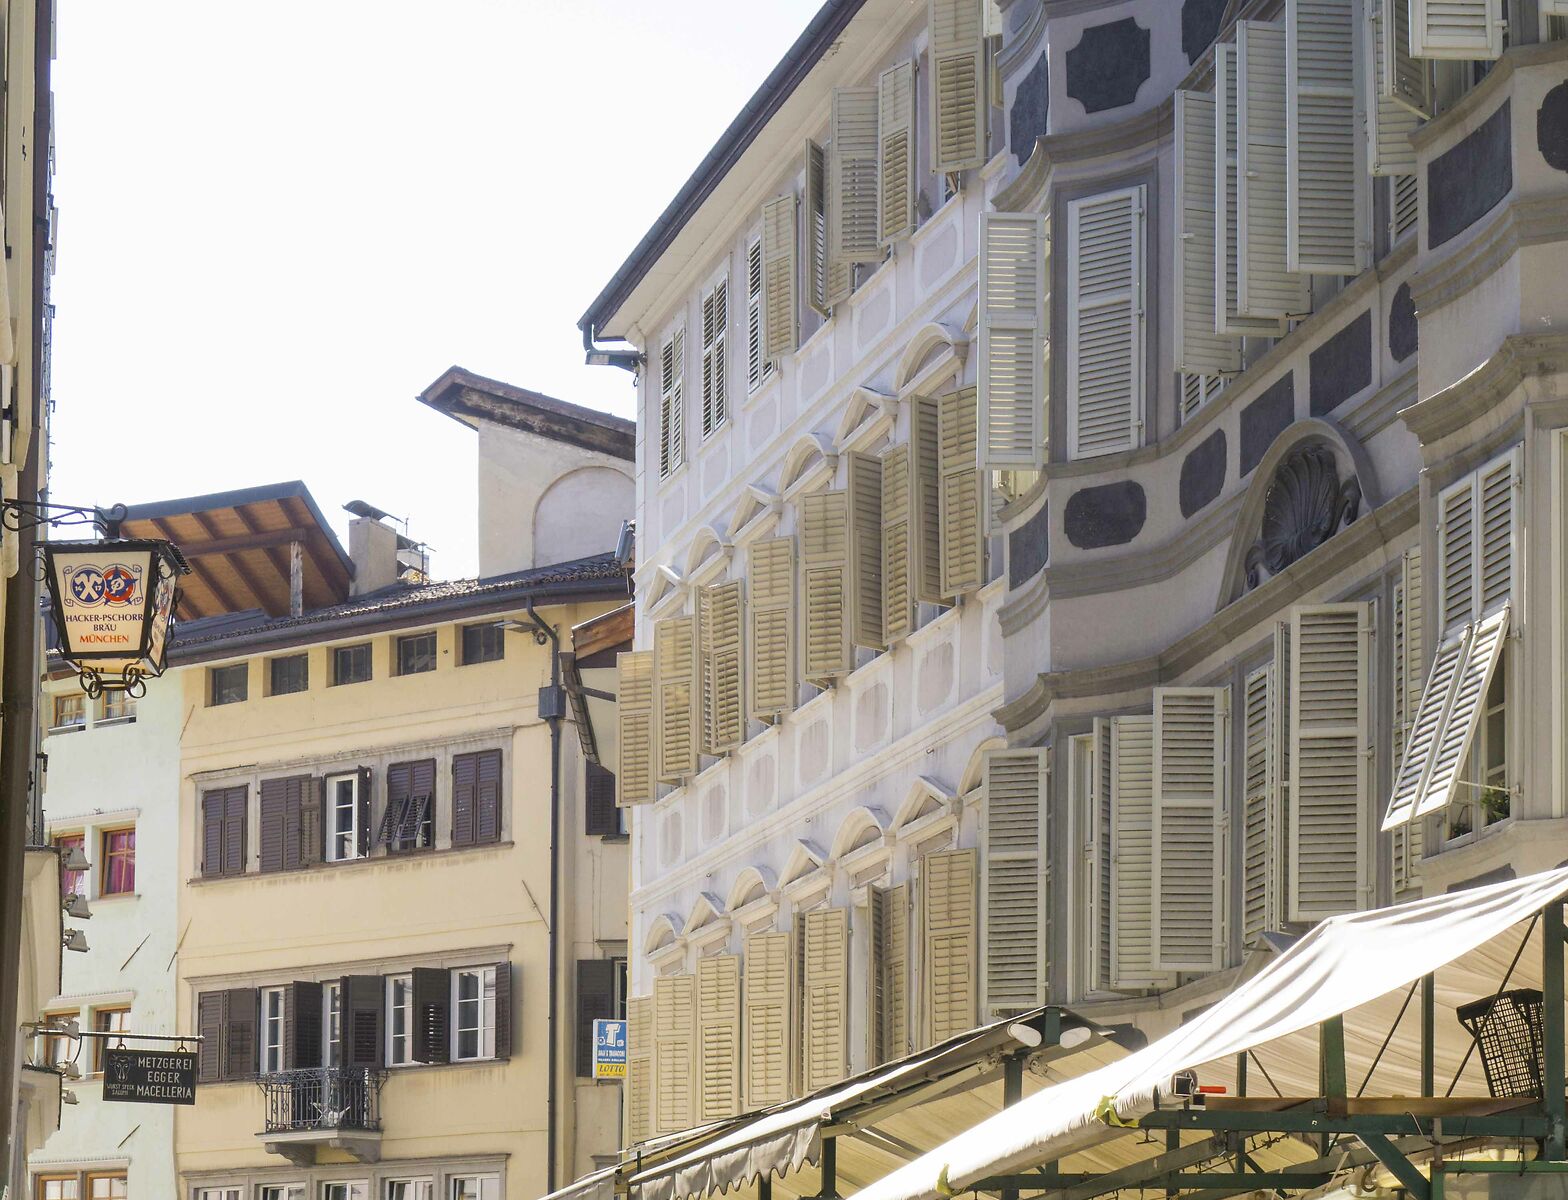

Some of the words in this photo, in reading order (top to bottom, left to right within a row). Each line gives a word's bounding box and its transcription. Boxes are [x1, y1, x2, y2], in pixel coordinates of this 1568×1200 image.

[66, 613, 144, 622] HACKER-PSCHORR
[93, 623, 117, 631] BRÄU
[80, 634, 129, 643] MÜNCHEN
[138, 1056, 192, 1070] METZGEREI
[147, 1071, 180, 1083] EGGER
[136, 1085, 192, 1098] MACELLERIA
